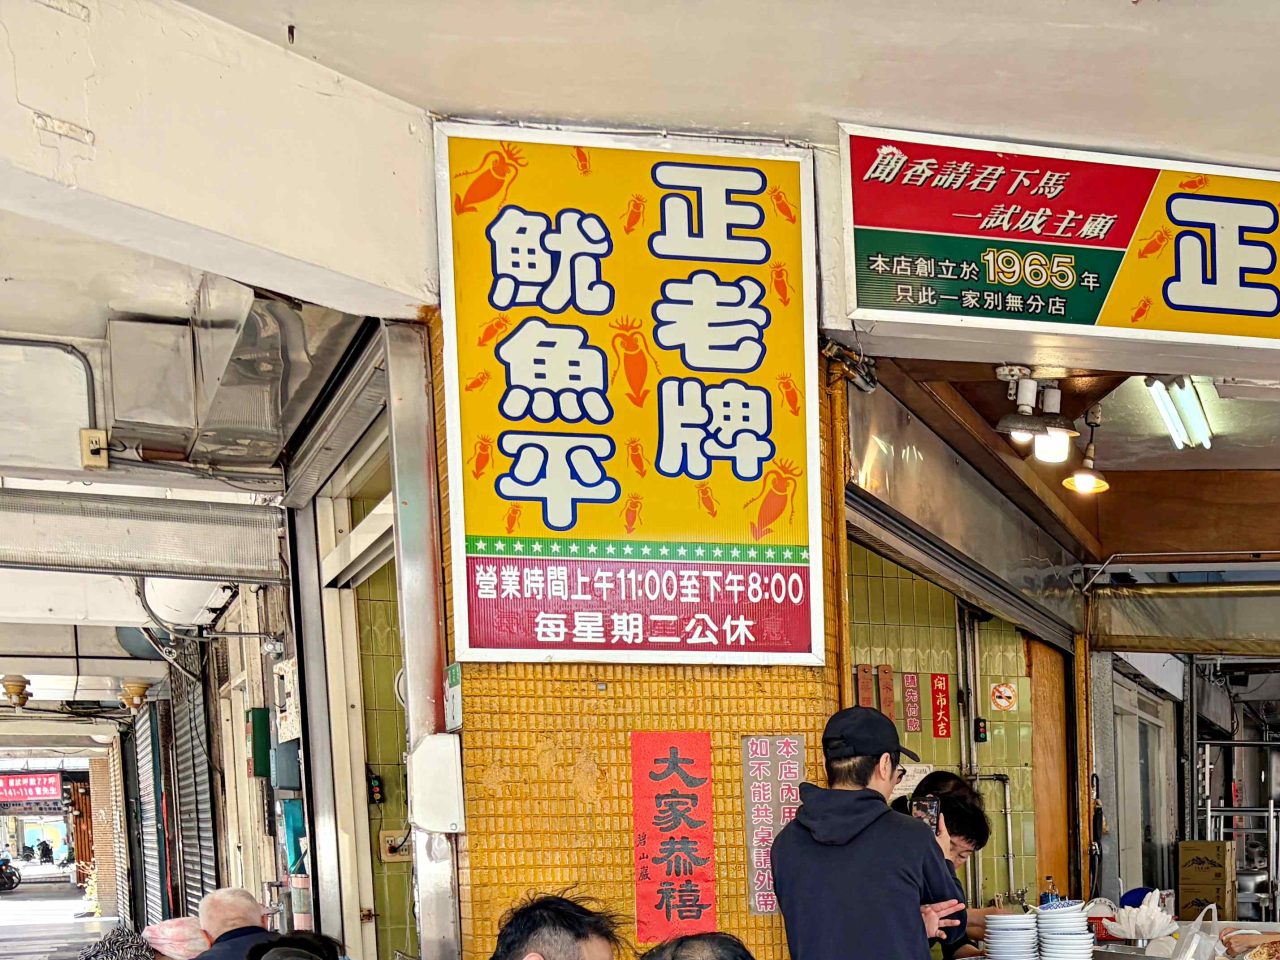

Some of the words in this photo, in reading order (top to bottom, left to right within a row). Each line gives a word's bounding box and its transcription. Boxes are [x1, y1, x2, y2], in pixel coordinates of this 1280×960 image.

[951, 203, 1119, 241] 一試成主顧
[648, 160, 777, 482] 正老牌
[895, 285, 1067, 316] 只此一家別無分店
[485, 204, 621, 532] 魷魚平
[475, 566, 804, 605] 營業時間上午11:00至下午8:00
[533, 611, 756, 646] 每星期二公休
[933, 675, 949, 737] 開市大吉
[648, 746, 712, 922] 大家恭禧
[747, 737, 777, 913] 如不能共桌請外帶
